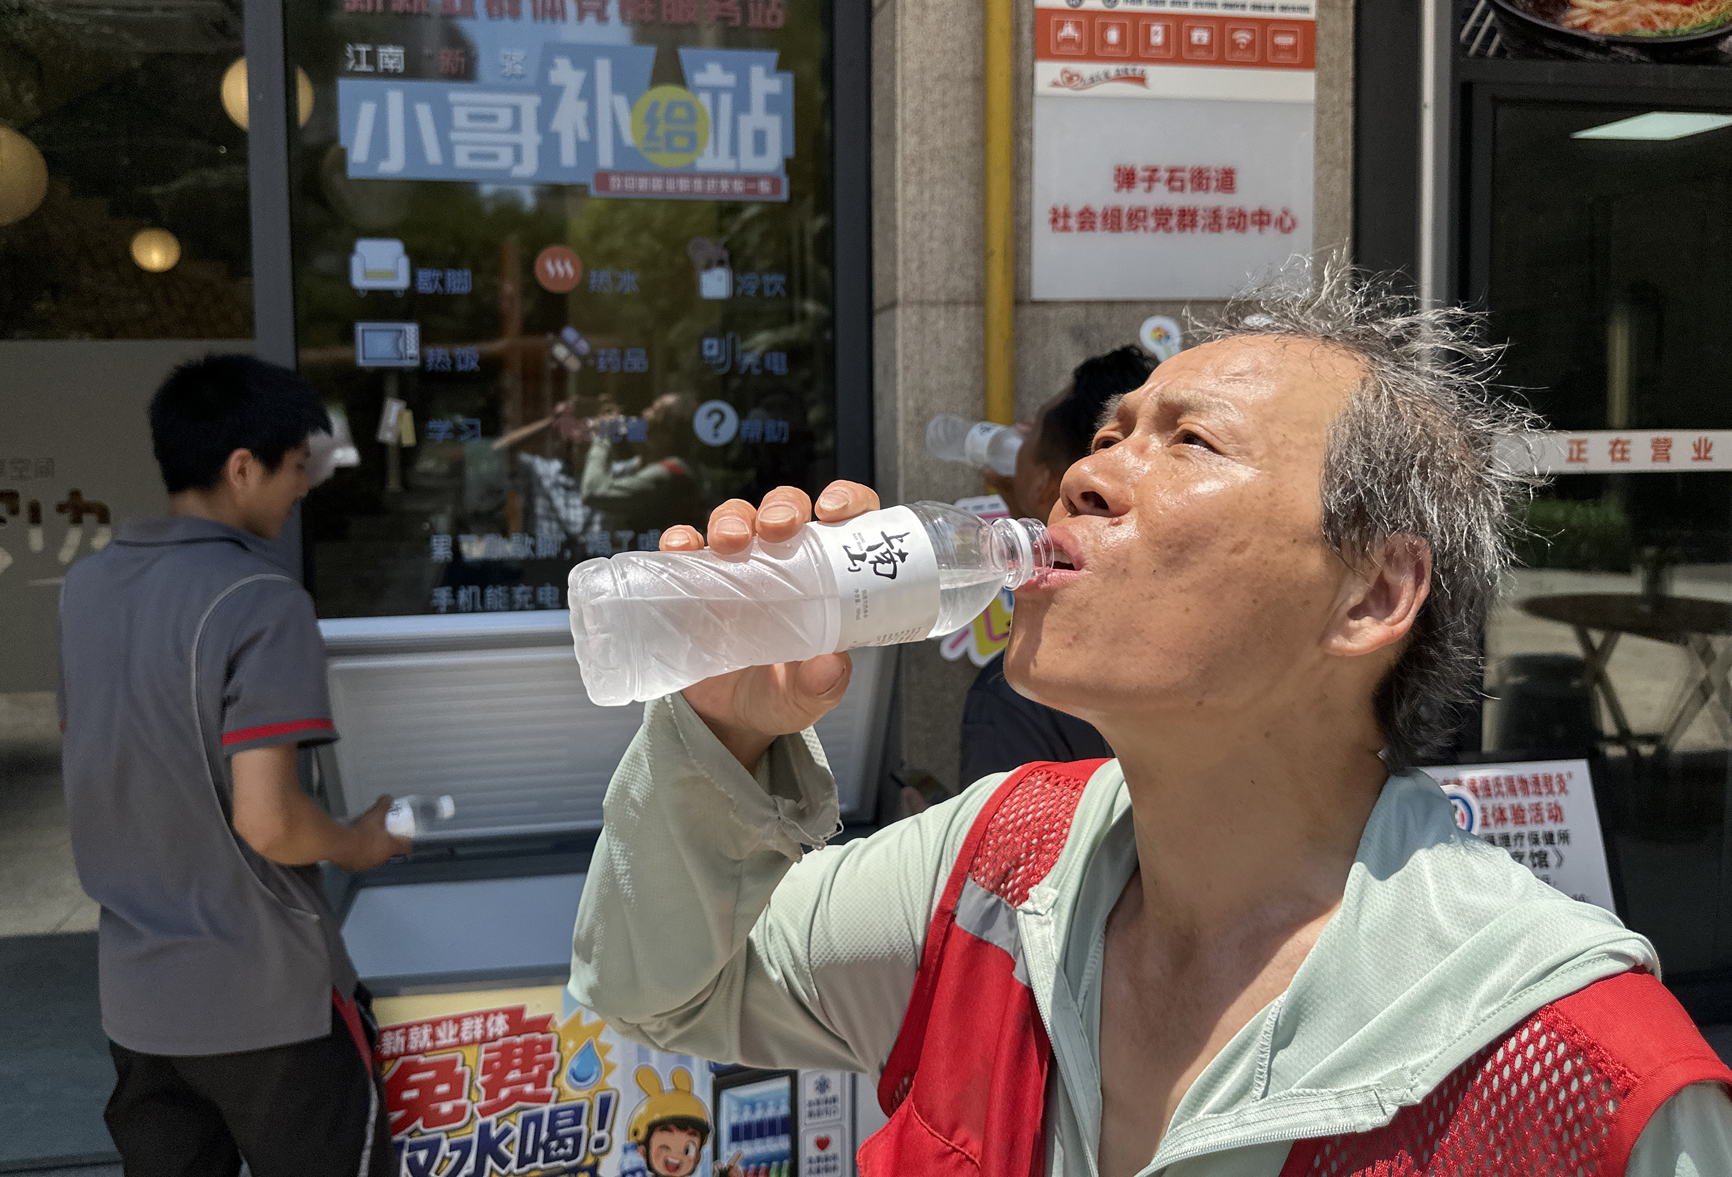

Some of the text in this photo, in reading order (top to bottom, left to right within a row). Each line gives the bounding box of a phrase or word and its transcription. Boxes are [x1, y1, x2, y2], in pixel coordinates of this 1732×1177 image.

[351, 55, 786, 177] 小哥补给站
[1113, 164, 1237, 194] 弹子石街道
[1049, 205, 1298, 235] 社会组织党群活动中心
[589, 269, 640, 294] 热水
[736, 272, 787, 298] 冷饮
[425, 347, 481, 373] 热饭
[596, 347, 649, 374] 药品
[739, 349, 789, 376] 充电
[427, 417, 482, 443] 学习
[740, 419, 789, 444] 帮助
[1566, 436, 1713, 463] 正在营业
[431, 584, 561, 613] 手机能充电
[379, 1011, 510, 1057] 新就业群体
[384, 1032, 560, 1138] 免费
